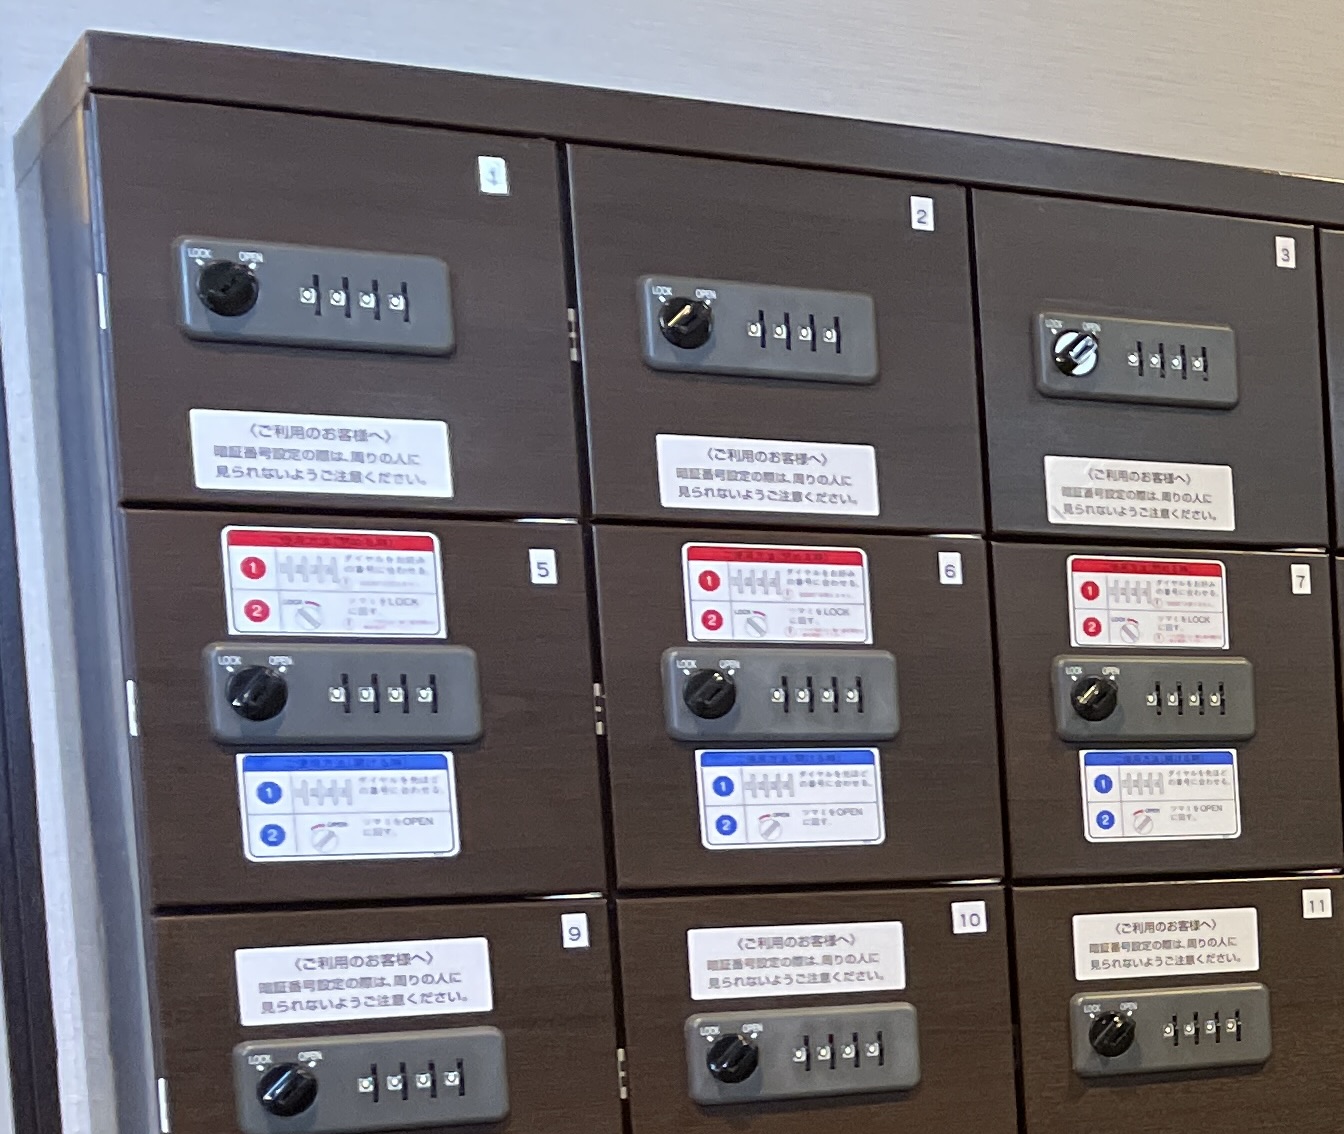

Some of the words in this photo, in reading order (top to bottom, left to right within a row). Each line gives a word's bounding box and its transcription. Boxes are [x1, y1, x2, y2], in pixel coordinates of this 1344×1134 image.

[489, 167, 498, 185] 1
[917, 210, 926, 224] 2
[1282, 249, 1290, 262] 3
[537, 562, 549, 577] 5
[945, 564, 956, 578] 6
[1296, 575, 1305, 588] 7
[1309, 899, 1325, 913] 11
[961, 913, 981, 928] 10
[568, 926, 581, 941] 9
